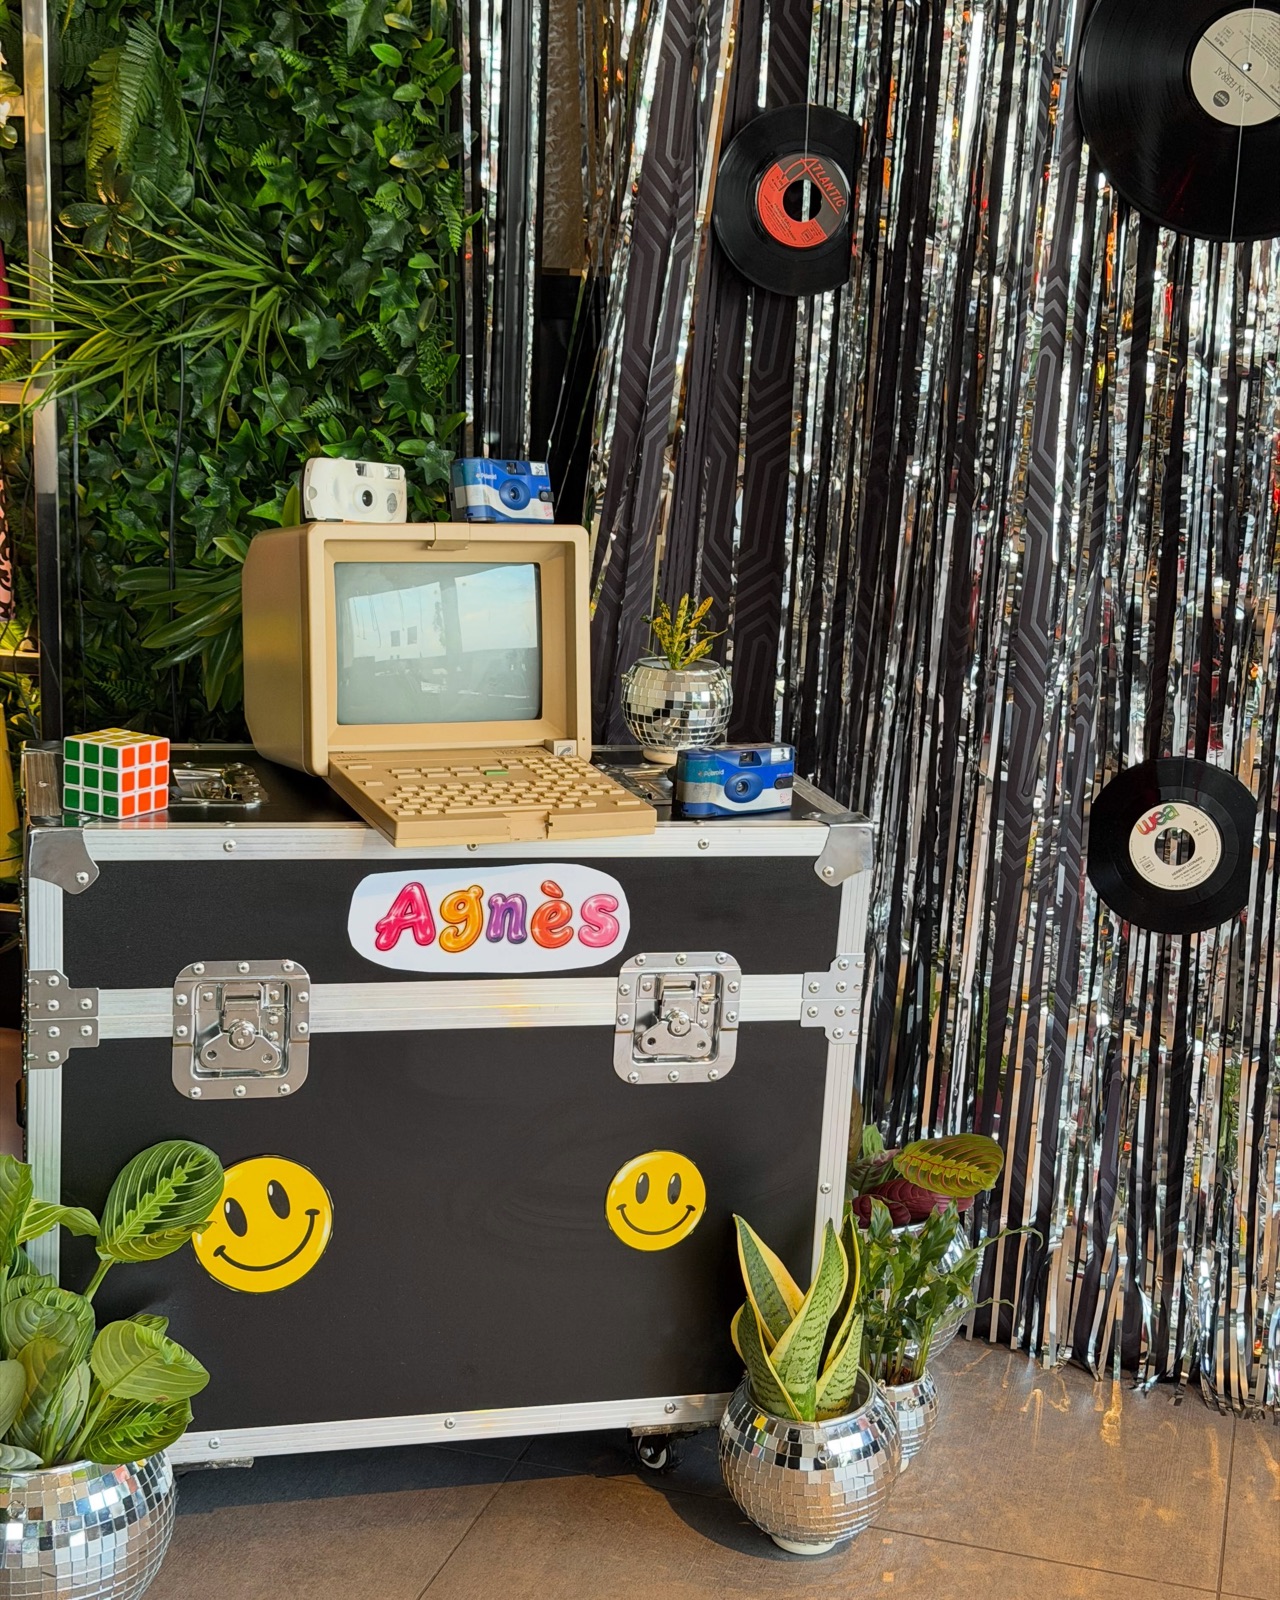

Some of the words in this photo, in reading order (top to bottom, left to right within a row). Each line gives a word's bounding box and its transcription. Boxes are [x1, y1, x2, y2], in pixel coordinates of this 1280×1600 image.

[1213, 66, 1238, 89] FERRAT
[779, 157, 847, 215] ATLANTIC
[1135, 804, 1180, 836] wea
[375, 879, 621, 954] Agnès
